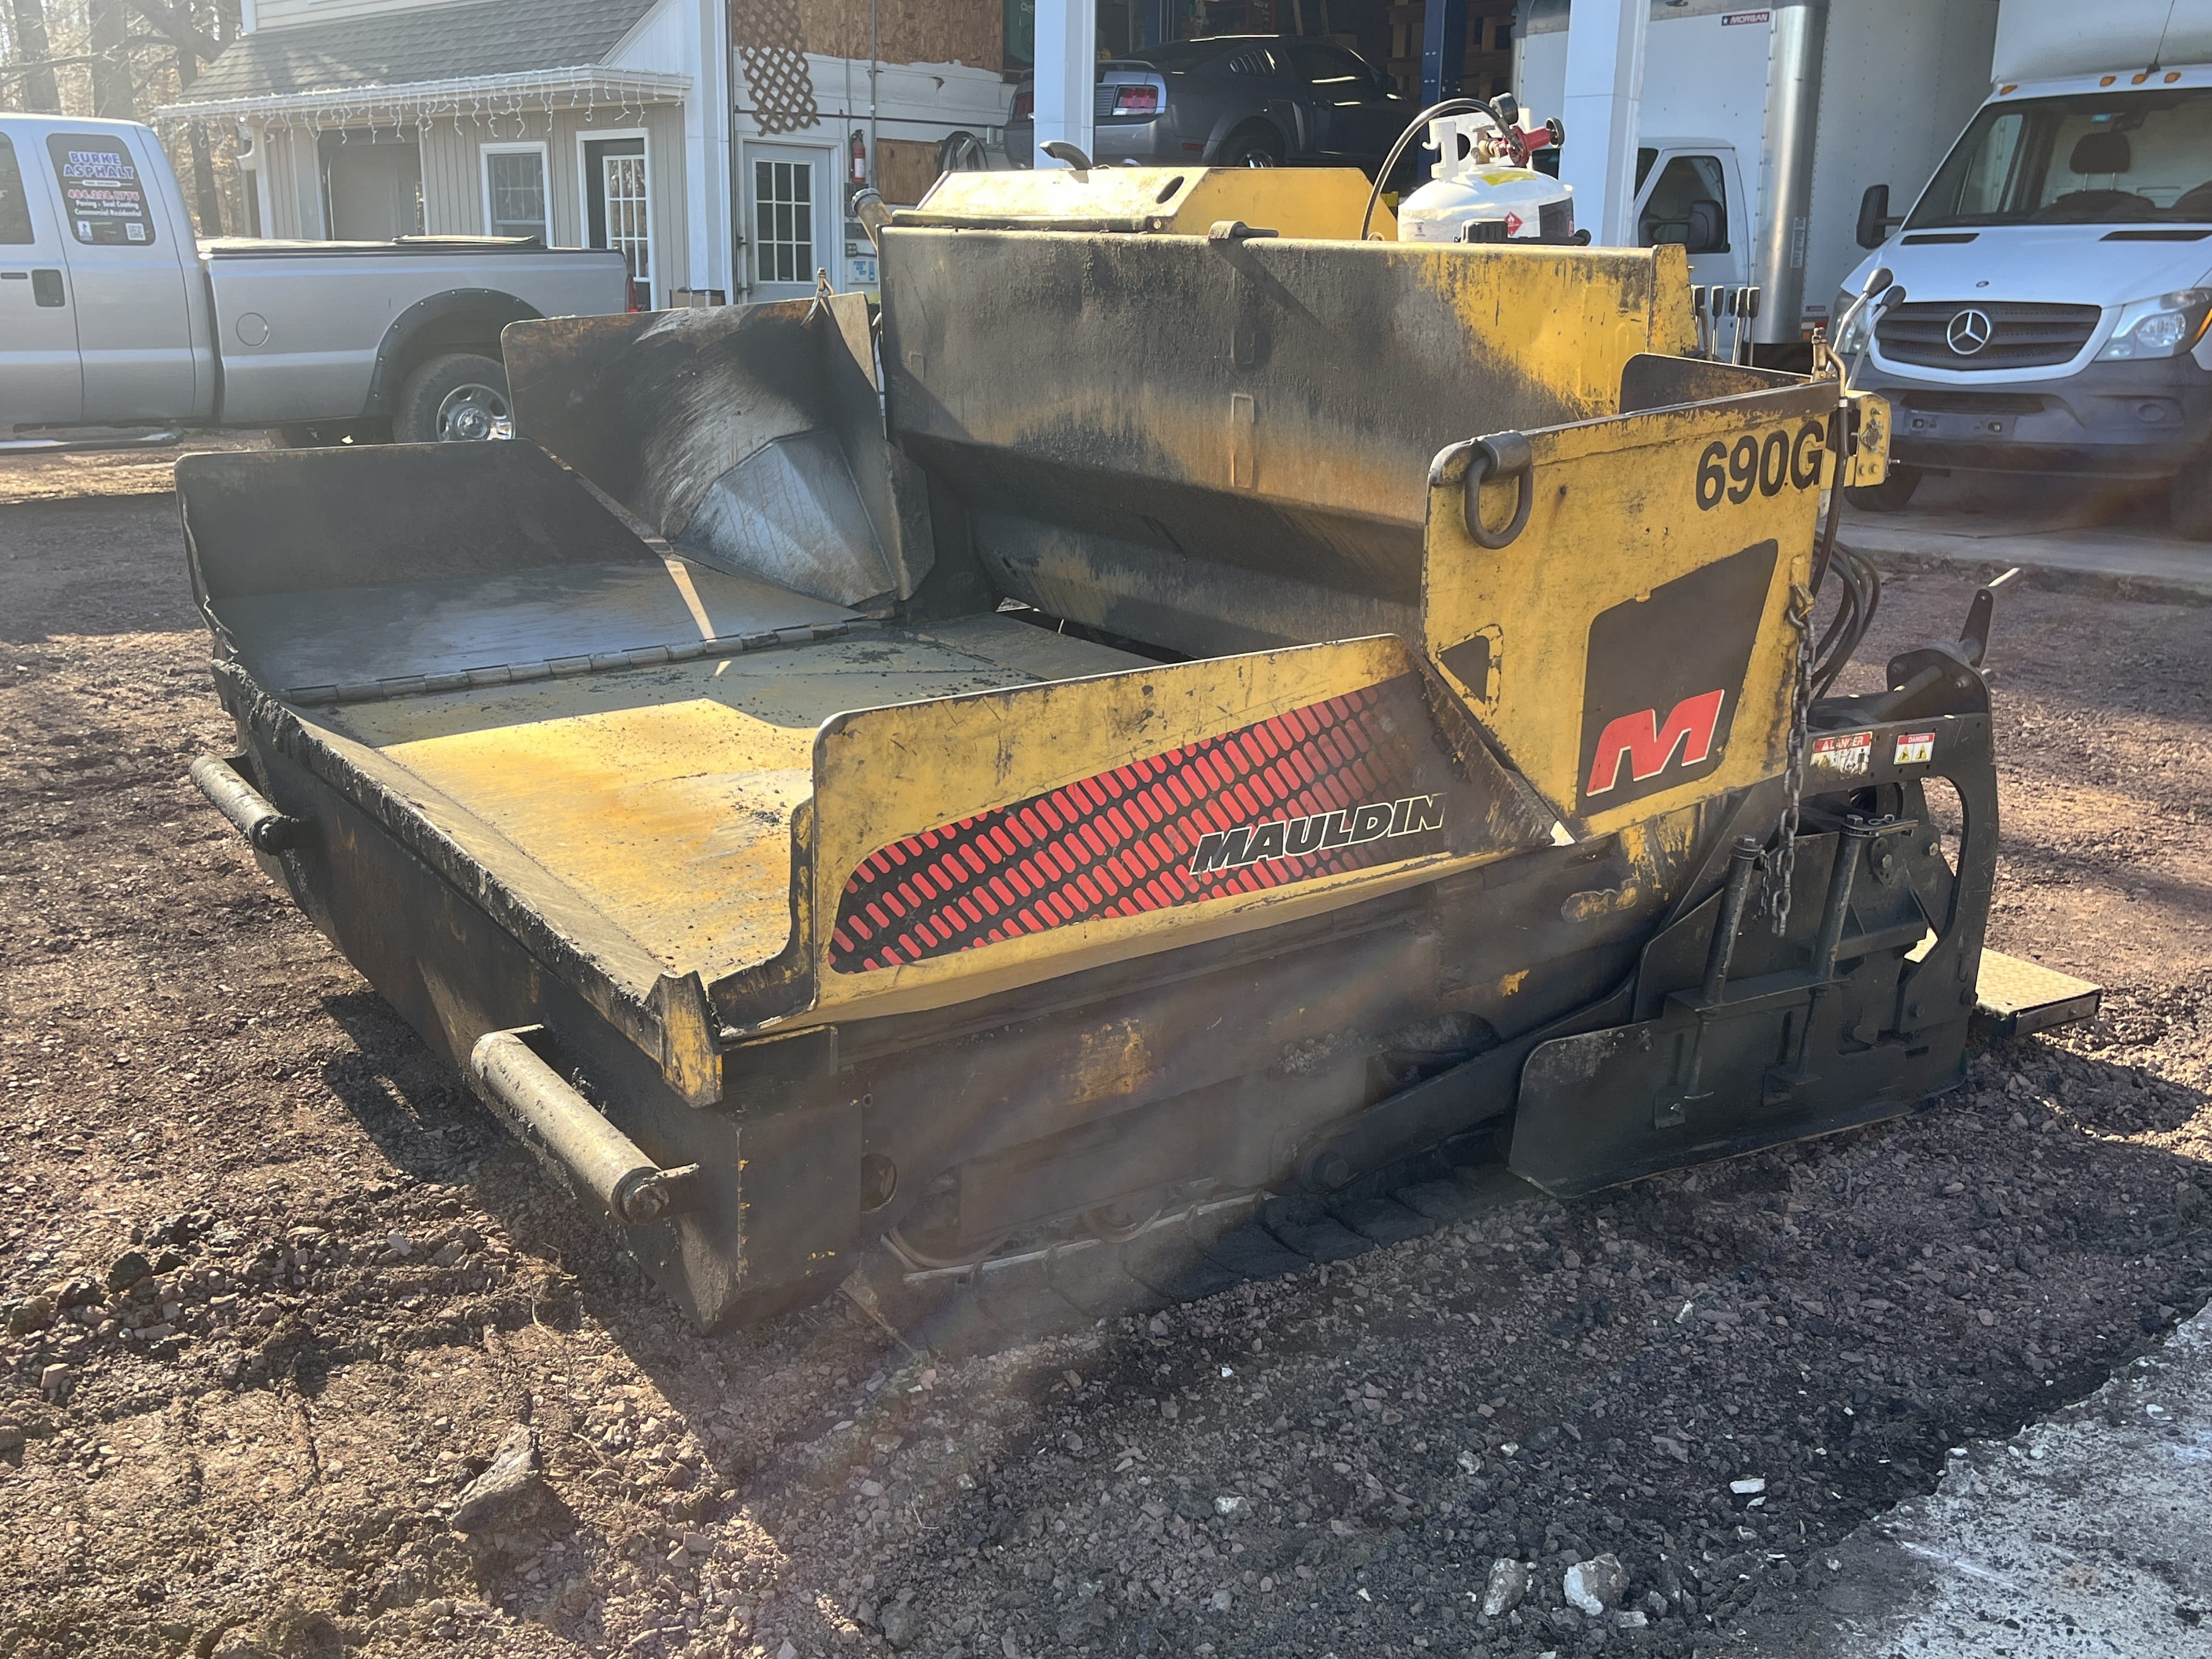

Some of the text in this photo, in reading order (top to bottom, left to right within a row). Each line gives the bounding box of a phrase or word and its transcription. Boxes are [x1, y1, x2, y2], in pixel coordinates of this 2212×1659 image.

[1729, 13, 1768, 24] MORGAN
[68, 151, 121, 165] BURKE
[64, 164, 134, 179] ASPHALT
[1696, 420, 1824, 511] 690G
[1586, 689, 1725, 797] M
[1908, 735, 1929, 743] DANGER
[1189, 792, 1448, 876] MAULDIN
